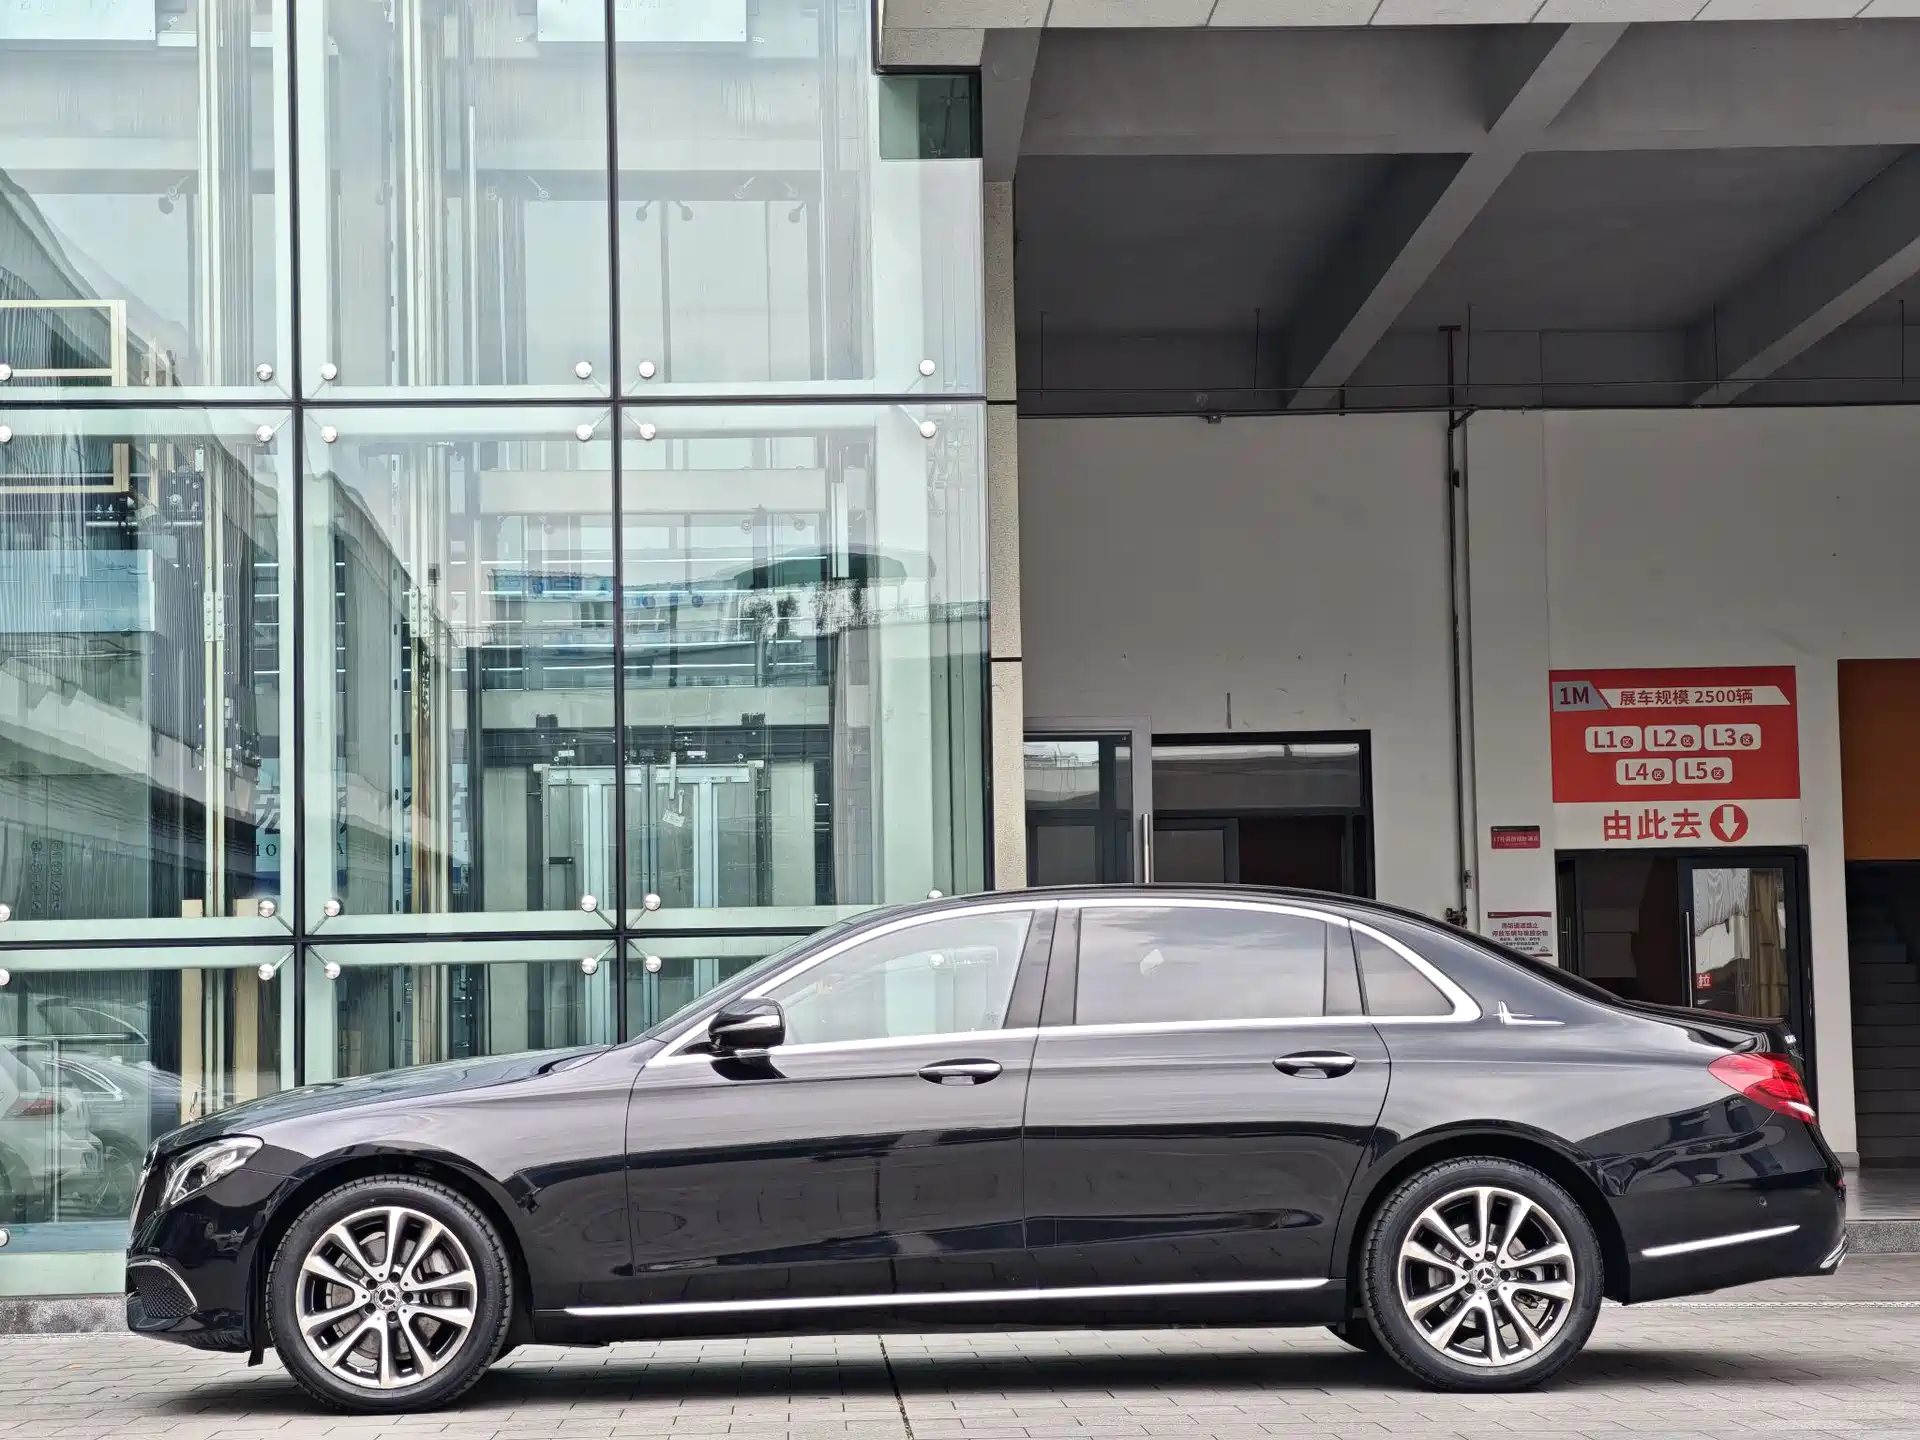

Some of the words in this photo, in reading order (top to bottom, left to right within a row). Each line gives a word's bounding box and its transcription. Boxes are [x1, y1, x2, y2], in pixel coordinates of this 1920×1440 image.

[1559, 686, 1590, 705] 1M
[1619, 689, 1690, 706] 展车规模
[1694, 688, 1754, 704] 2500辆
[1603, 808, 1702, 841] 由此去
[1698, 974, 1711, 987] 拉
